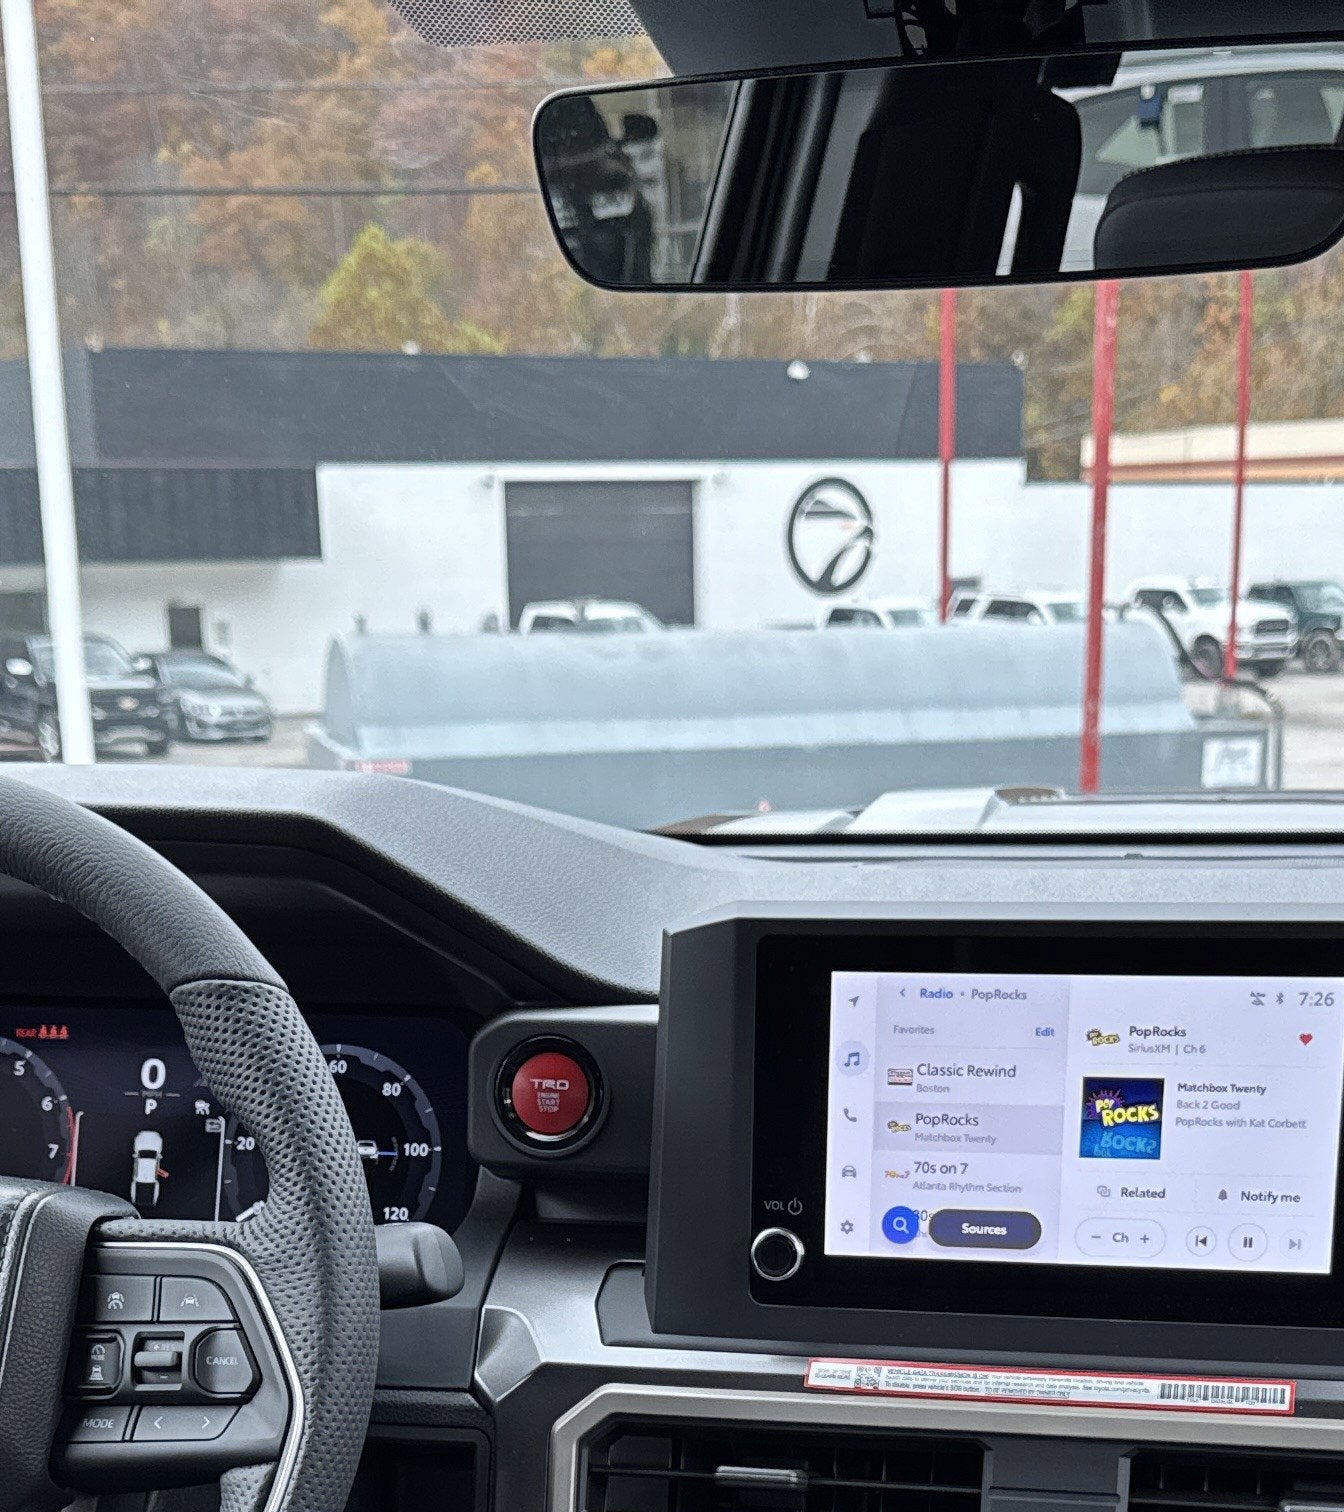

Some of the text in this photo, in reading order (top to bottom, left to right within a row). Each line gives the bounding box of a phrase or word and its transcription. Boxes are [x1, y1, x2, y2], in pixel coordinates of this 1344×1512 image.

[920, 988, 1027, 1002] Radio PopRocks
[1298, 992, 1335, 1007] 7:26
[16, 1029, 37, 1038] REAR
[893, 1025, 935, 1035] Favorites
[1035, 1027, 1055, 1037] Edit
[1128, 1044, 1170, 1054] SiriusXM
[13, 1060, 26, 1077] 5
[140, 1057, 167, 1090] 0
[329, 1060, 348, 1074] 60
[916, 1063, 964, 1077] Classic
[967, 1065, 1017, 1078] Rewind
[382, 1083, 401, 1097] 80
[530, 1078, 570, 1091] TRD
[916, 1084, 950, 1093] Boston
[1177, 1083, 1267, 1096] Matchbox Twenty
[41, 1096, 54, 1111] 6
[145, 1098, 157, 1115] P
[1177, 1100, 1241, 1110] Back 2 Good
[915, 1112, 979, 1127] PopRocks
[1101, 1103, 1159, 1126] ROCKS
[1175, 1117, 1307, 1129] PopRocks with Kat Corbett
[236, 1136, 256, 1151] 20
[914, 1132, 997, 1146] Matchbox Twenty
[48, 1143, 59, 1160] 7
[403, 1143, 429, 1157] 100
[913, 1161, 969, 1174] 70s on 7
[912, 1181, 1022, 1193] Atlanta Rhythm Section
[1120, 1187, 1166, 1199] Related
[1241, 1190, 1301, 1205] Notify me
[763, 1200, 785, 1210] VOL
[383, 1207, 409, 1221] 120
[961, 1222, 1007, 1236] Sources
[1112, 1232, 1129, 1243] Ch
[206, 1355, 239, 1366] CANCEL
[82, 1418, 114, 1429] MODE
